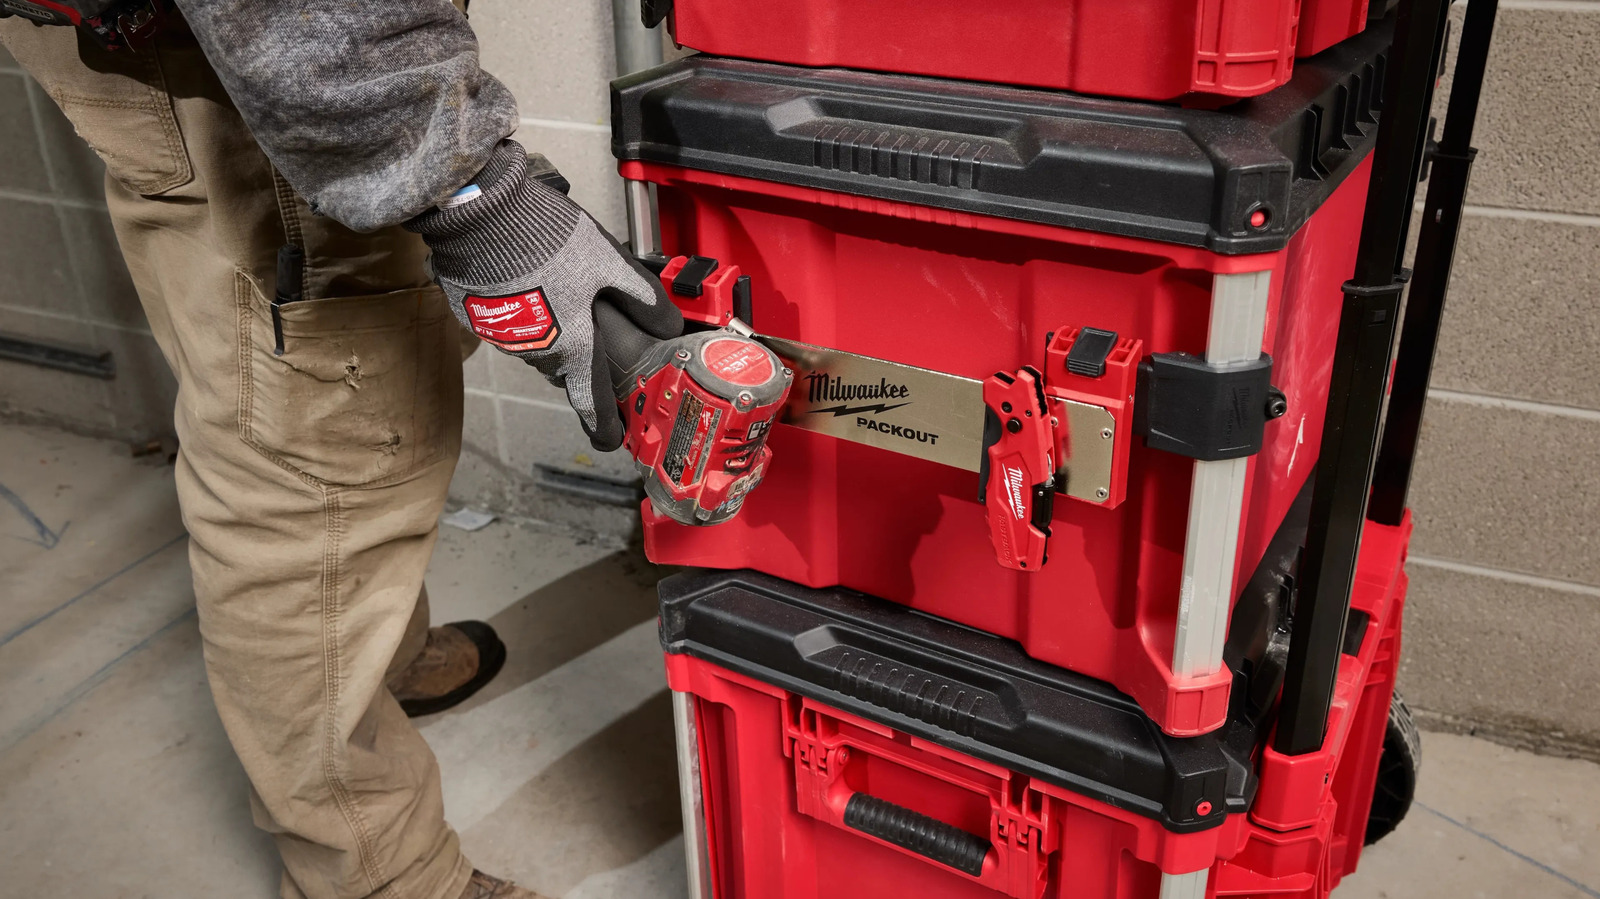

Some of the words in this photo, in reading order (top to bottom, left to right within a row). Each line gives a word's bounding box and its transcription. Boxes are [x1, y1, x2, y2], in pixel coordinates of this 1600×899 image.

[470, 301, 522, 317] Milwaukee
[802, 370, 910, 403] Milwaukee
[857, 417, 939, 445] PACKOUT
[1008, 467, 1025, 519] Milwaukee
